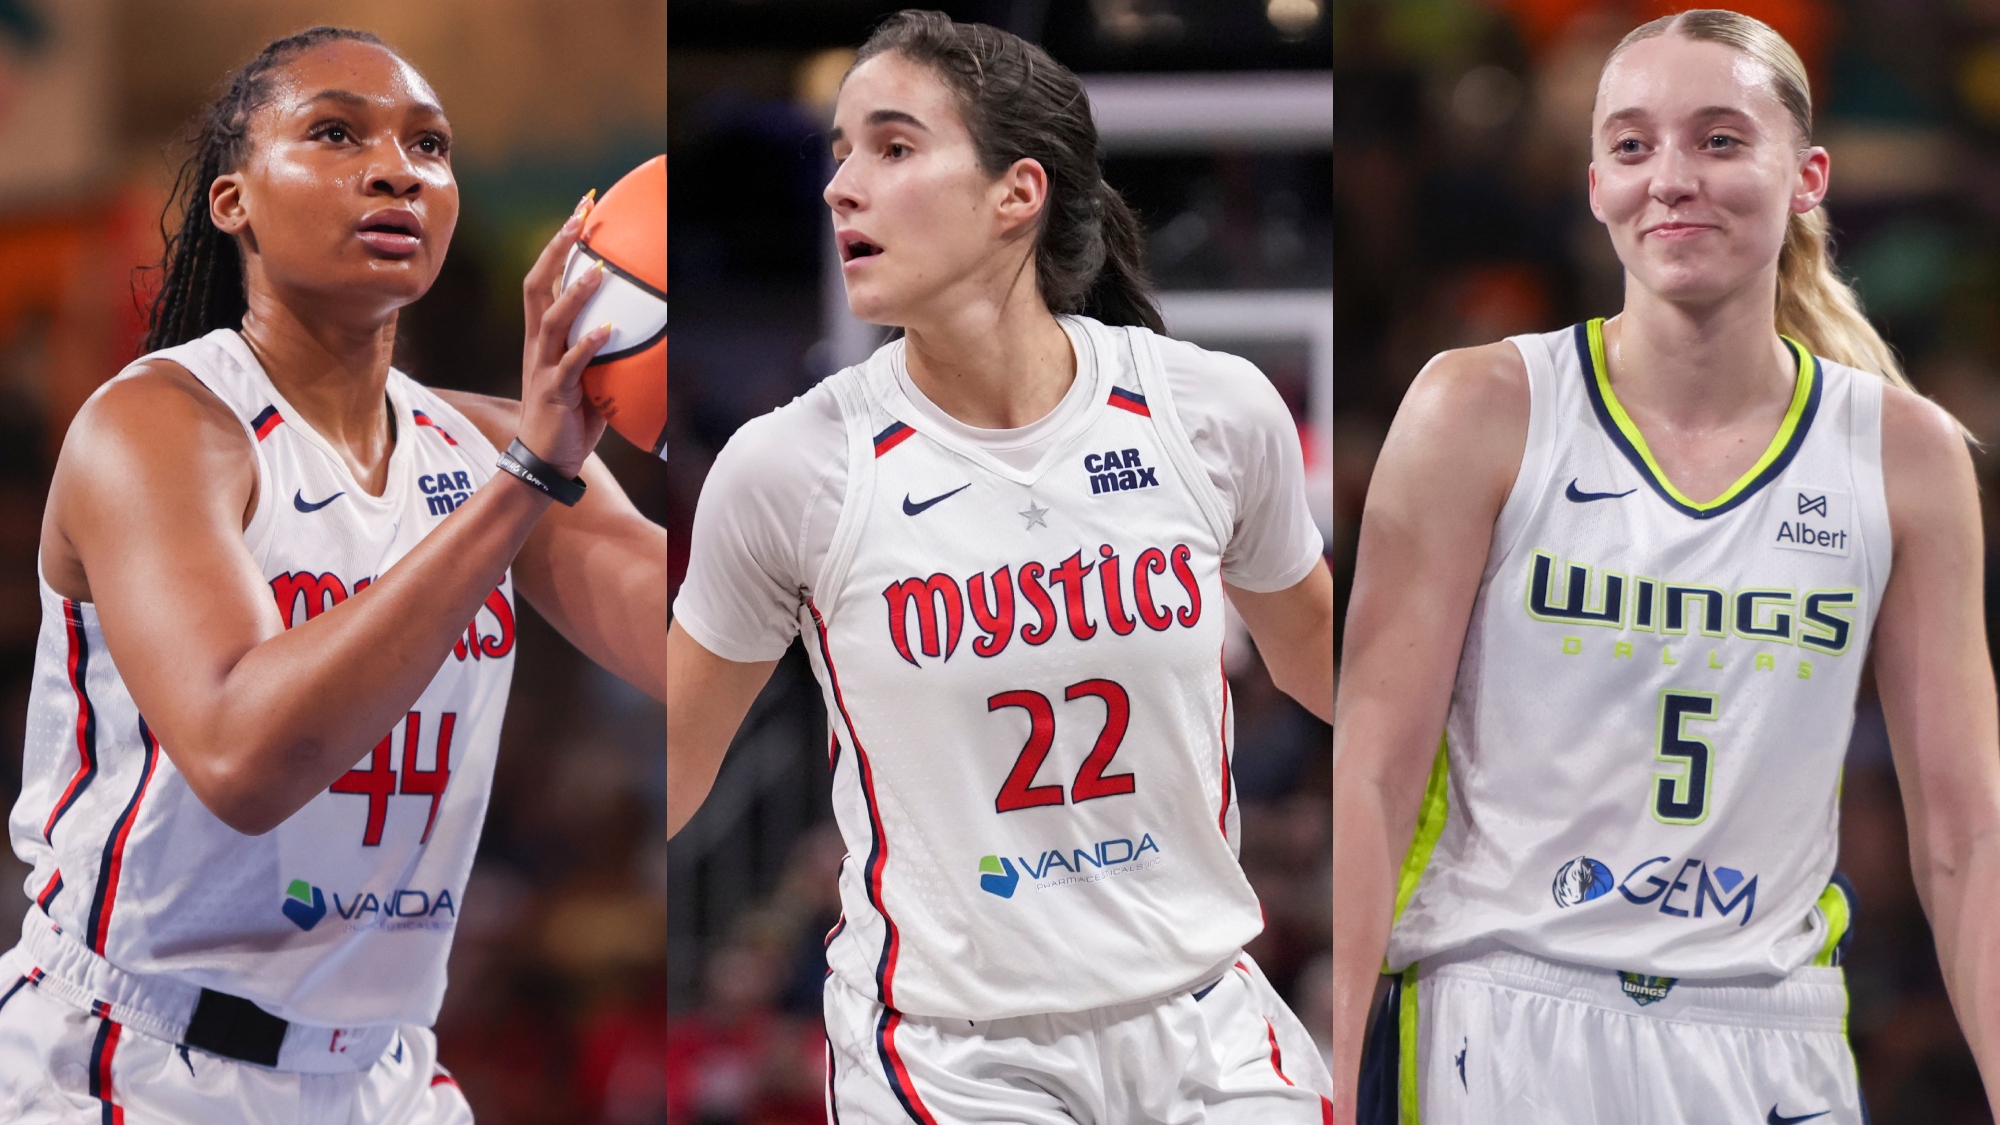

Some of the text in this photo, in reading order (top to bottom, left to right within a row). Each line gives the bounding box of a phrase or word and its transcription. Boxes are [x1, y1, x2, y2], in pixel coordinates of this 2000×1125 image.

[418, 470, 472, 495] CAR
[1084, 448, 1142, 474] CAR
[1089, 467, 1160, 495] max
[426, 491, 475, 516] ma
[1776, 521, 1847, 550] Albert
[1562, 636, 1814, 680] DALLAS
[987, 678, 1136, 814] 22
[1651, 688, 1720, 826] 5
[329, 711, 457, 847] 44
[1018, 832, 1160, 880] VANDA
[1616, 856, 1759, 927] GEM
